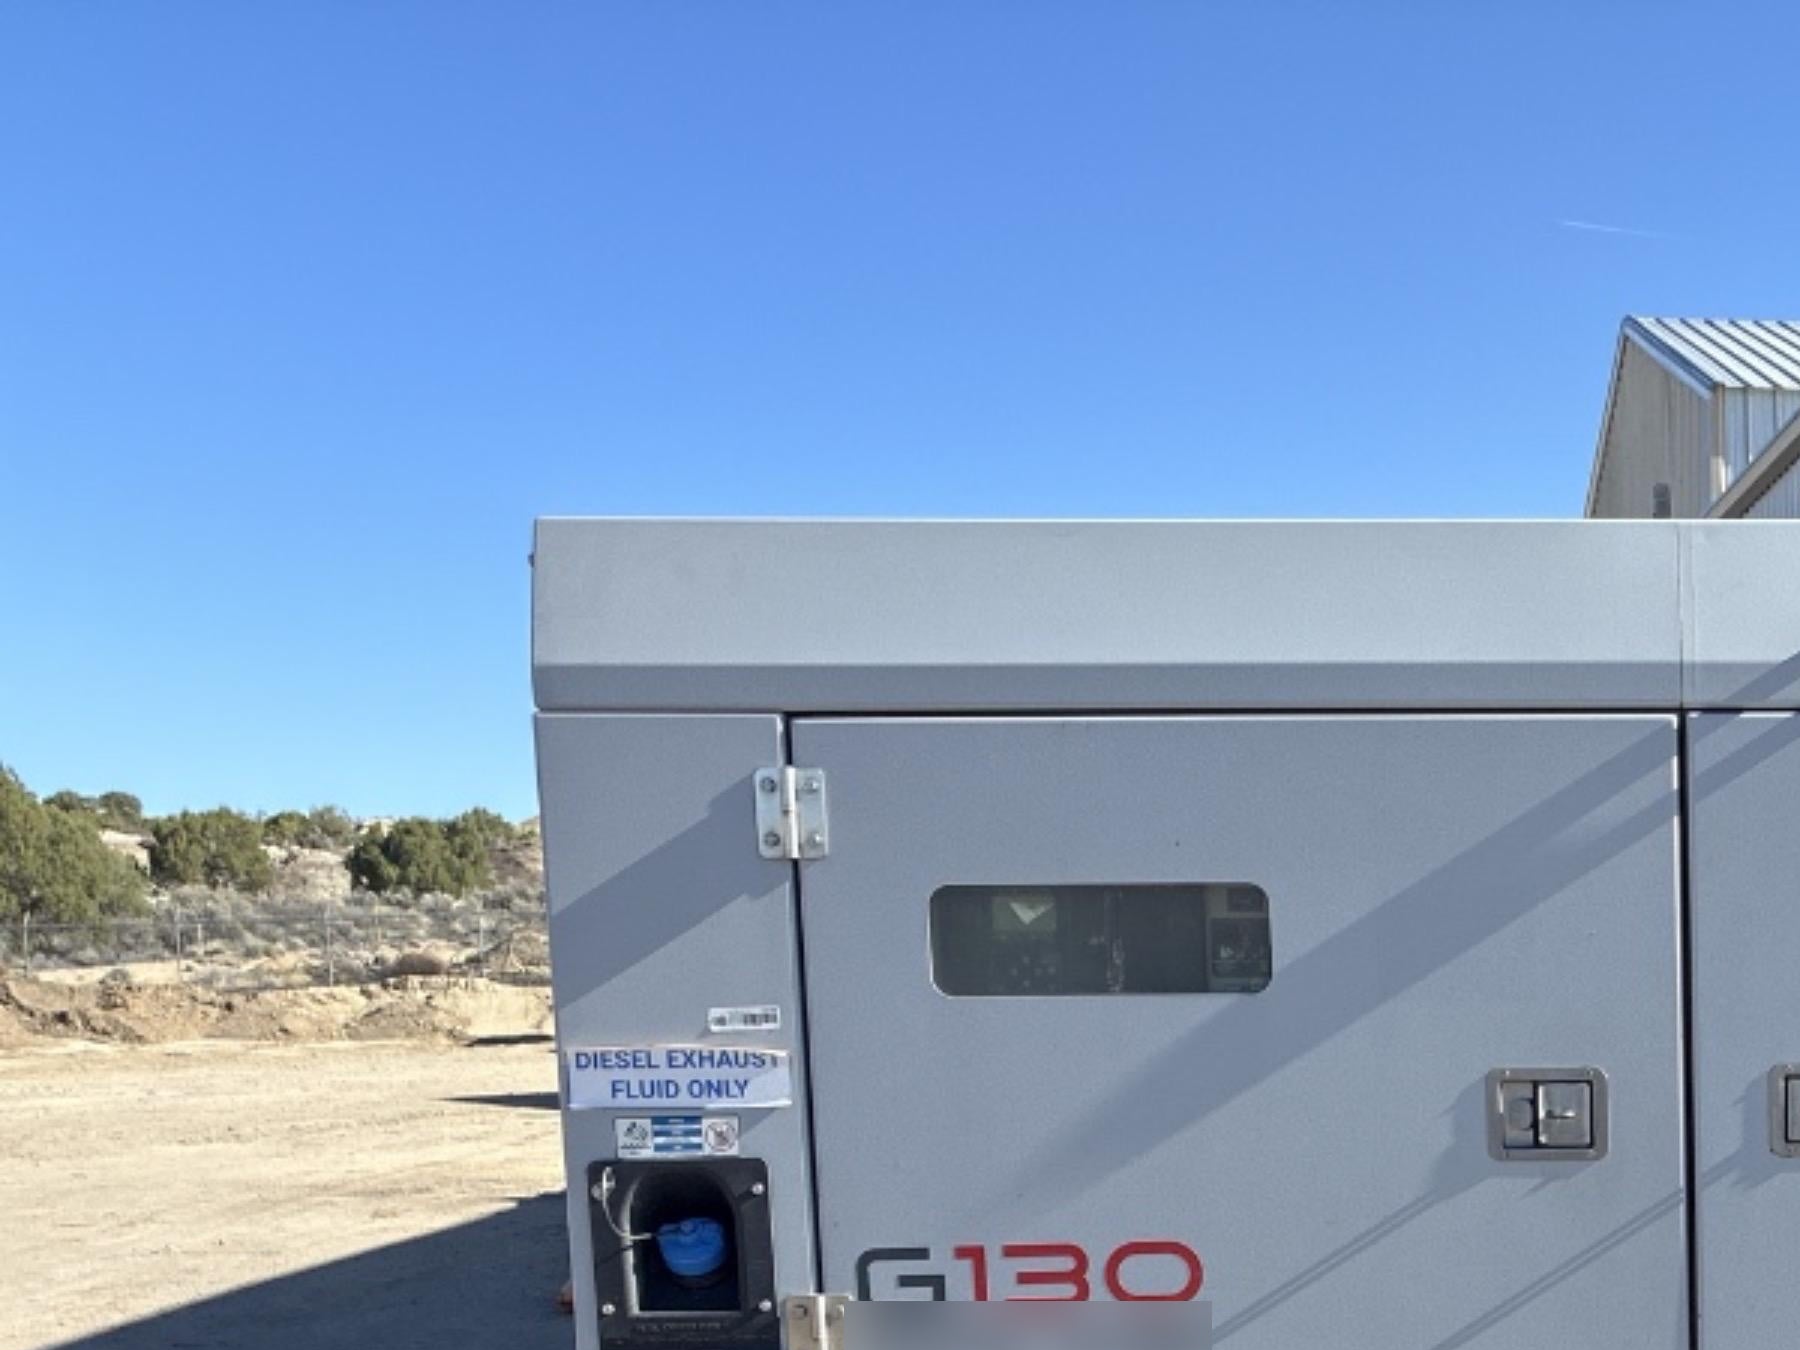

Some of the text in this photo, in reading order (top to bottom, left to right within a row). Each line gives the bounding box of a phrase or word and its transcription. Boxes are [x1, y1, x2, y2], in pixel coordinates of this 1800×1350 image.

[575, 1049, 779, 1069] DIESEL EXHAUST
[611, 1078, 748, 1098] FLUID ONLY
[856, 1241, 1203, 1301] G130
